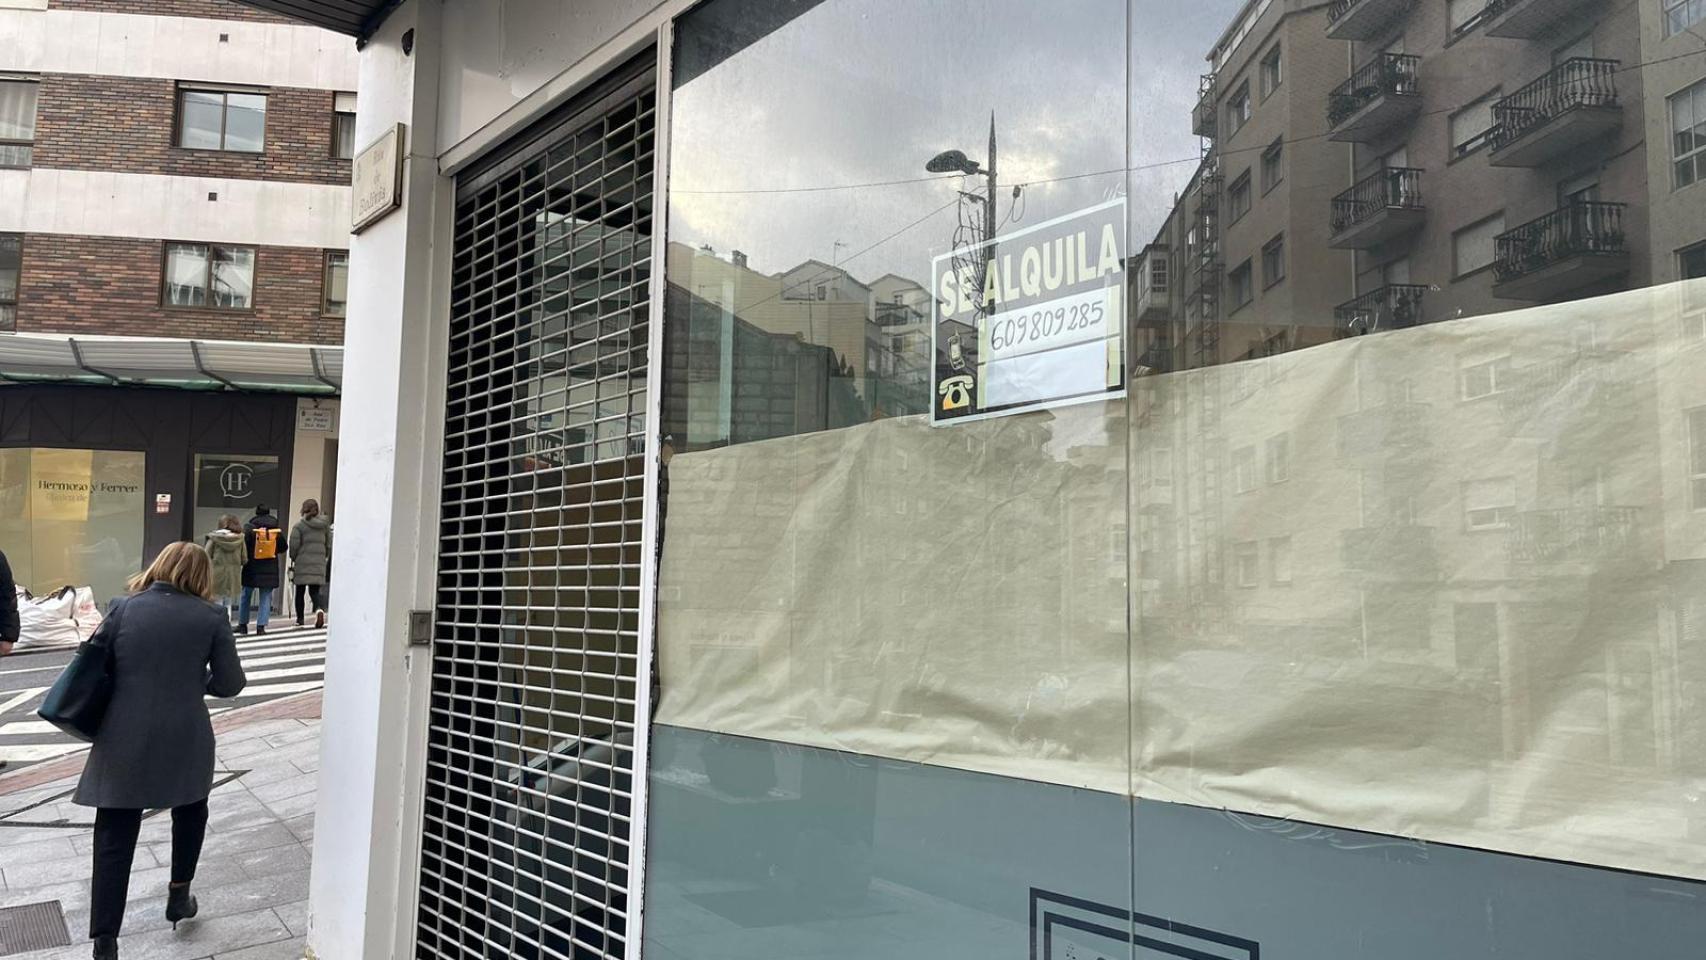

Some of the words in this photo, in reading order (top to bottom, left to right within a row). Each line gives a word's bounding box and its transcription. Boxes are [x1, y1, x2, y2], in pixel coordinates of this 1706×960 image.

[939, 265, 974, 317] SE
[982, 223, 1121, 307] ALQUILA
[990, 300, 1104, 351] 609809285
[38, 480, 88, 491] Hermoso
[90, 484, 97, 494] y
[100, 483, 138, 493] Ferrer
